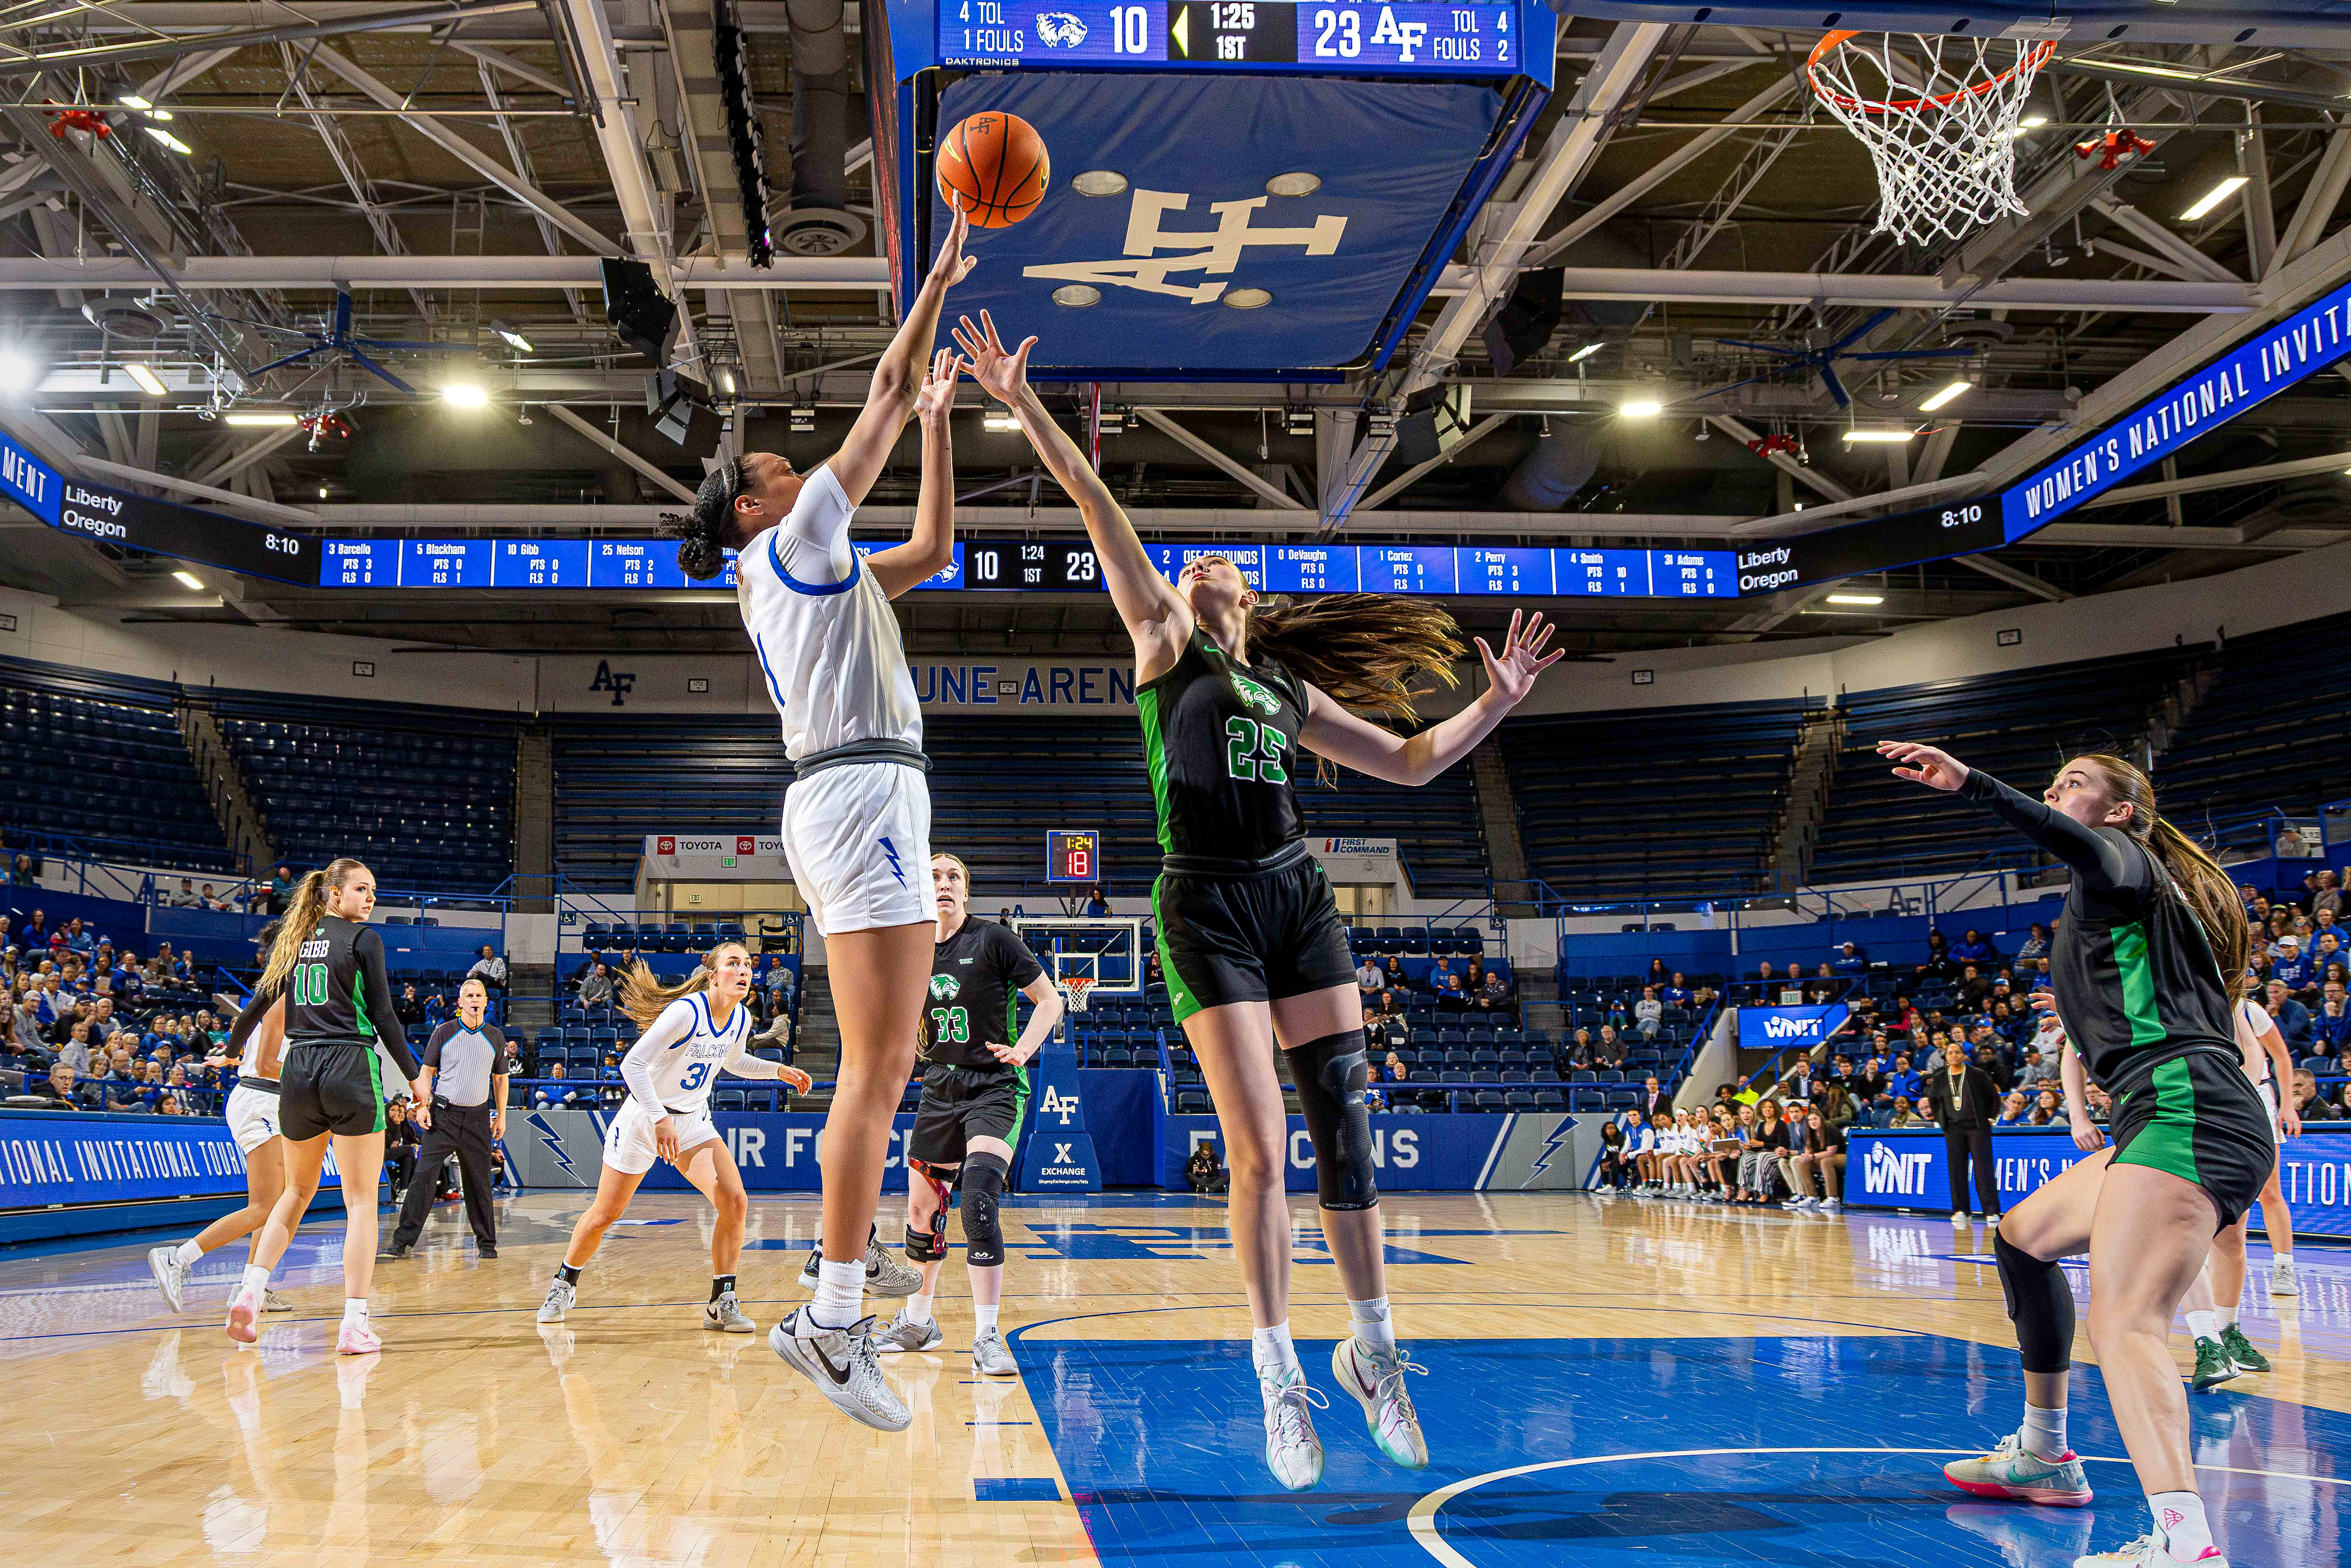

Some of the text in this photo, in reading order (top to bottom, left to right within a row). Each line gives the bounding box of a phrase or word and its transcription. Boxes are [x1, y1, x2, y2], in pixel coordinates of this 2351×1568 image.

[960, 1, 1005, 24] 4 TOL
[1211, 2, 1255, 30] 1:25
[1451, 10, 1508, 33] TOL 4
[1109, 6, 1148, 54] 10
[1314, 9, 1362, 58] 23
[1370, 6, 1428, 62] AF
[964, 28, 1024, 52] 1 FOULS
[1216, 35, 1245, 60] 1ST
[1433, 37, 1508, 61] FOULS 2
[946, 58, 1019, 66] DAKTRONICS
[2025, 437, 2120, 519] WOMEN'S
[2129, 369, 2250, 460] NATIONAL
[2, 447, 46, 503] MENT
[66, 485, 122, 516] Liberty
[1941, 505, 1982, 528] 8:10
[63, 510, 127, 538] Oregon
[266, 534, 299, 555] 8:10
[329, 544, 371, 554] 3 Barcello
[417, 544, 465, 554] 5 Blackham
[507, 544, 539, 555] 10 Gibb
[602, 544, 644, 555] 25 Nelson
[1021, 546, 1044, 559] 1:24
[1163, 549, 1171, 564] 2
[1278, 549, 1327, 562] 0 DeVaughn
[1380, 550, 1413, 562] 1 Cortez
[1475, 551, 1505, 564] 2 Perry
[1571, 553, 1603, 564] 4 Smith
[1738, 547, 1790, 569] Liberty
[343, 559, 372, 569] PTS 3
[434, 559, 462, 570] PTS 0
[530, 559, 558, 570] PTS 0
[625, 559, 653, 570] PTS 2
[726, 560, 736, 570] PT
[975, 551, 998, 579] 10
[1067, 552, 1095, 580] 23
[1664, 554, 1704, 566] 31 Adams
[1023, 568, 1041, 582] 1ST
[1301, 563, 1324, 574] PTS 0
[1393, 564, 1423, 575] PTS 0
[1488, 565, 1518, 576] PTS 3
[1587, 566, 1627, 578] PTS 10
[1681, 568, 1713, 579] PTS 0
[343, 572, 371, 583] FLS 0
[433, 572, 461, 583] FLS 1
[529, 573, 558, 583] FLS 0
[625, 573, 653, 584] FLS 0
[1301, 578, 1325, 589] FLS 0
[1394, 579, 1423, 590] FLS 1
[1740, 569, 1798, 590] Oregon
[1489, 580, 1519, 591] FLS 0
[1588, 582, 1625, 592] FLS 1
[1682, 583, 1714, 594] FLS 0
[590, 659, 635, 706] AF
[1225, 715, 1288, 785] 25
[680, 842, 722, 850] TOYOTA
[1067, 837, 1093, 850] 1:24
[1069, 851, 1088, 875] 18
[299, 940, 330, 958] GIBB
[294, 963, 329, 1006] 10
[931, 1006, 970, 1043] 33
[1763, 1017, 1823, 1038] WNIT
[685, 1043, 732, 1058] FALCONS
[680, 1062, 712, 1090] 31
[1040, 1085, 1079, 1125] AF
[728, 1128, 766, 1167] IR
[74, 1140, 201, 1182] INVITATIONAL
[1041, 1168, 1085, 1176] EXCHANGE
[1863, 1144, 1932, 1195] WNIT
